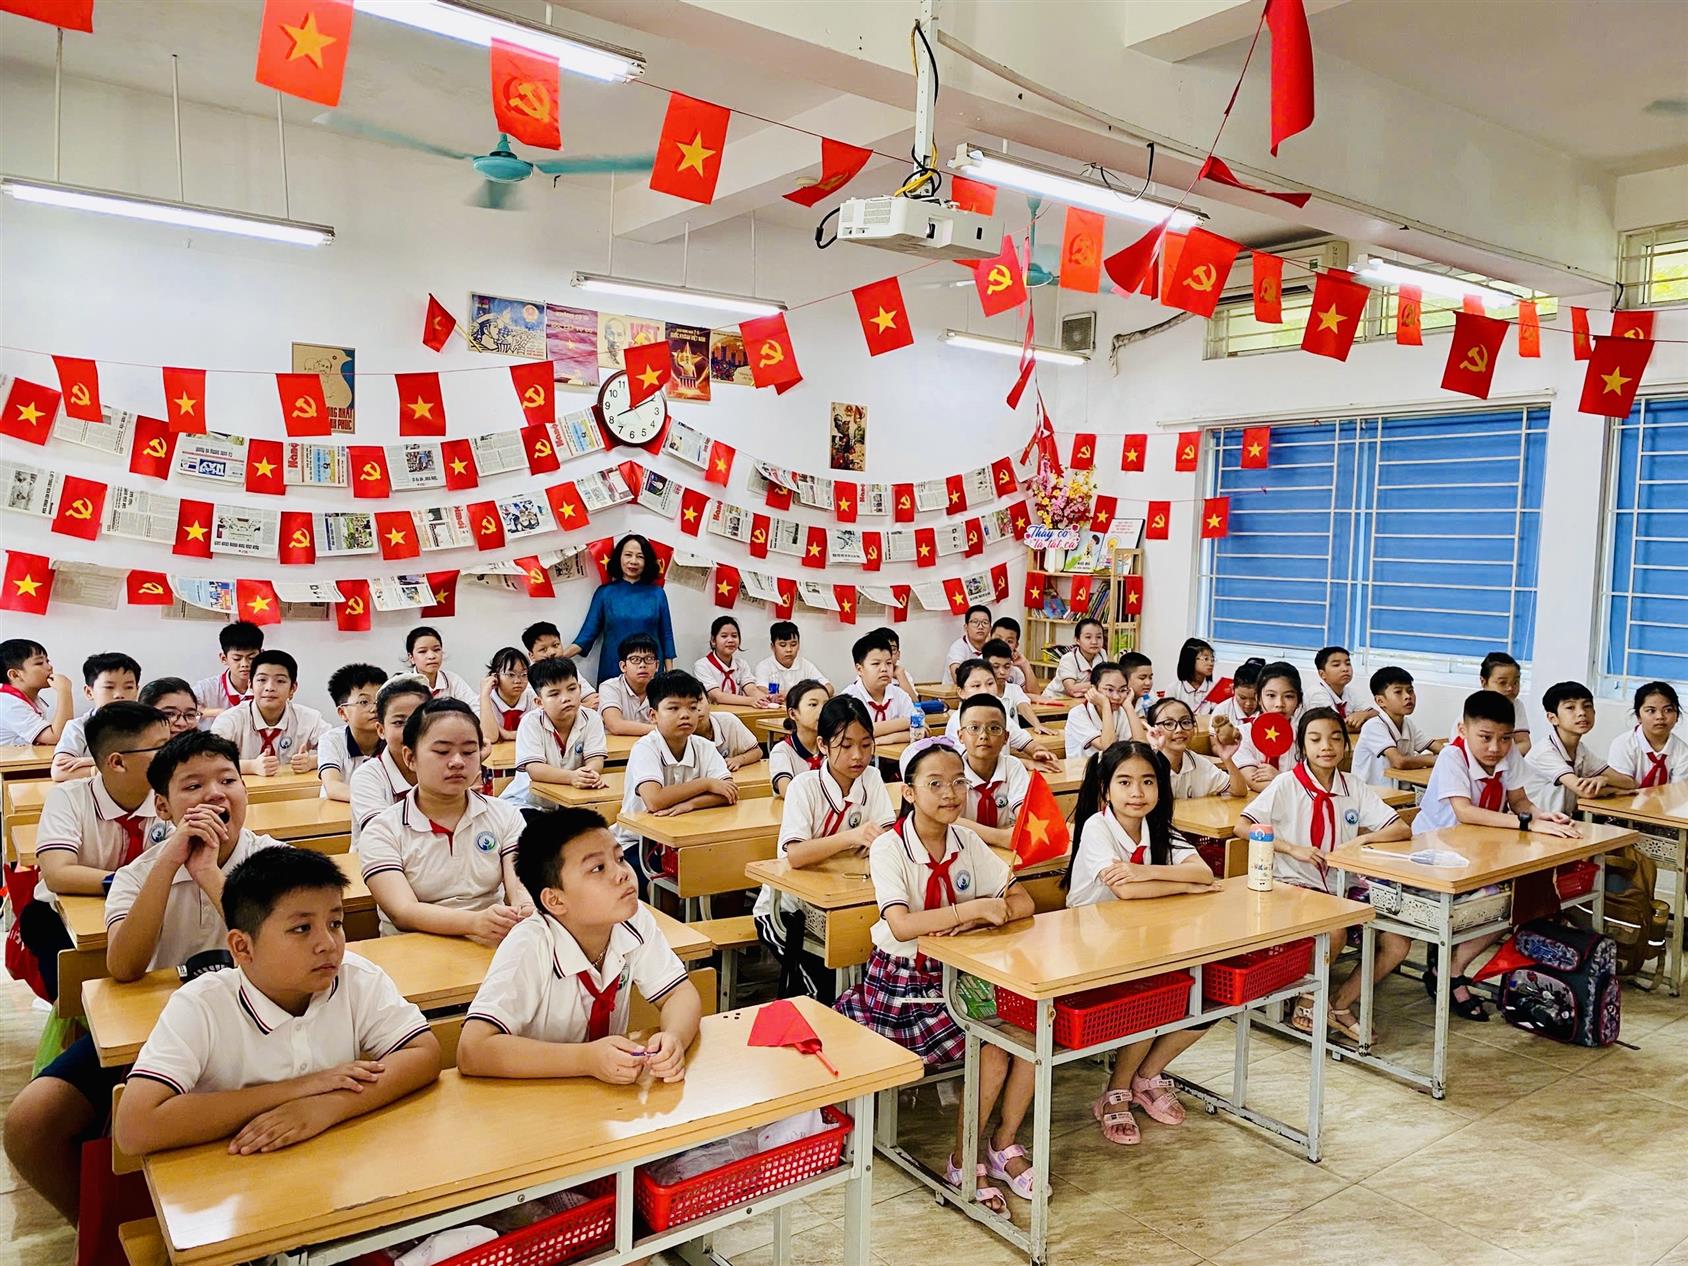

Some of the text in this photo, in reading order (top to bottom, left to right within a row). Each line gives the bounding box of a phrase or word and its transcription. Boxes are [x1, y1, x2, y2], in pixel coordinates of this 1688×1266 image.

[609, 390, 618, 398] 10
[618, 426, 624, 434] 7
[641, 428, 647, 437] 5
[629, 431, 635, 439] 6
